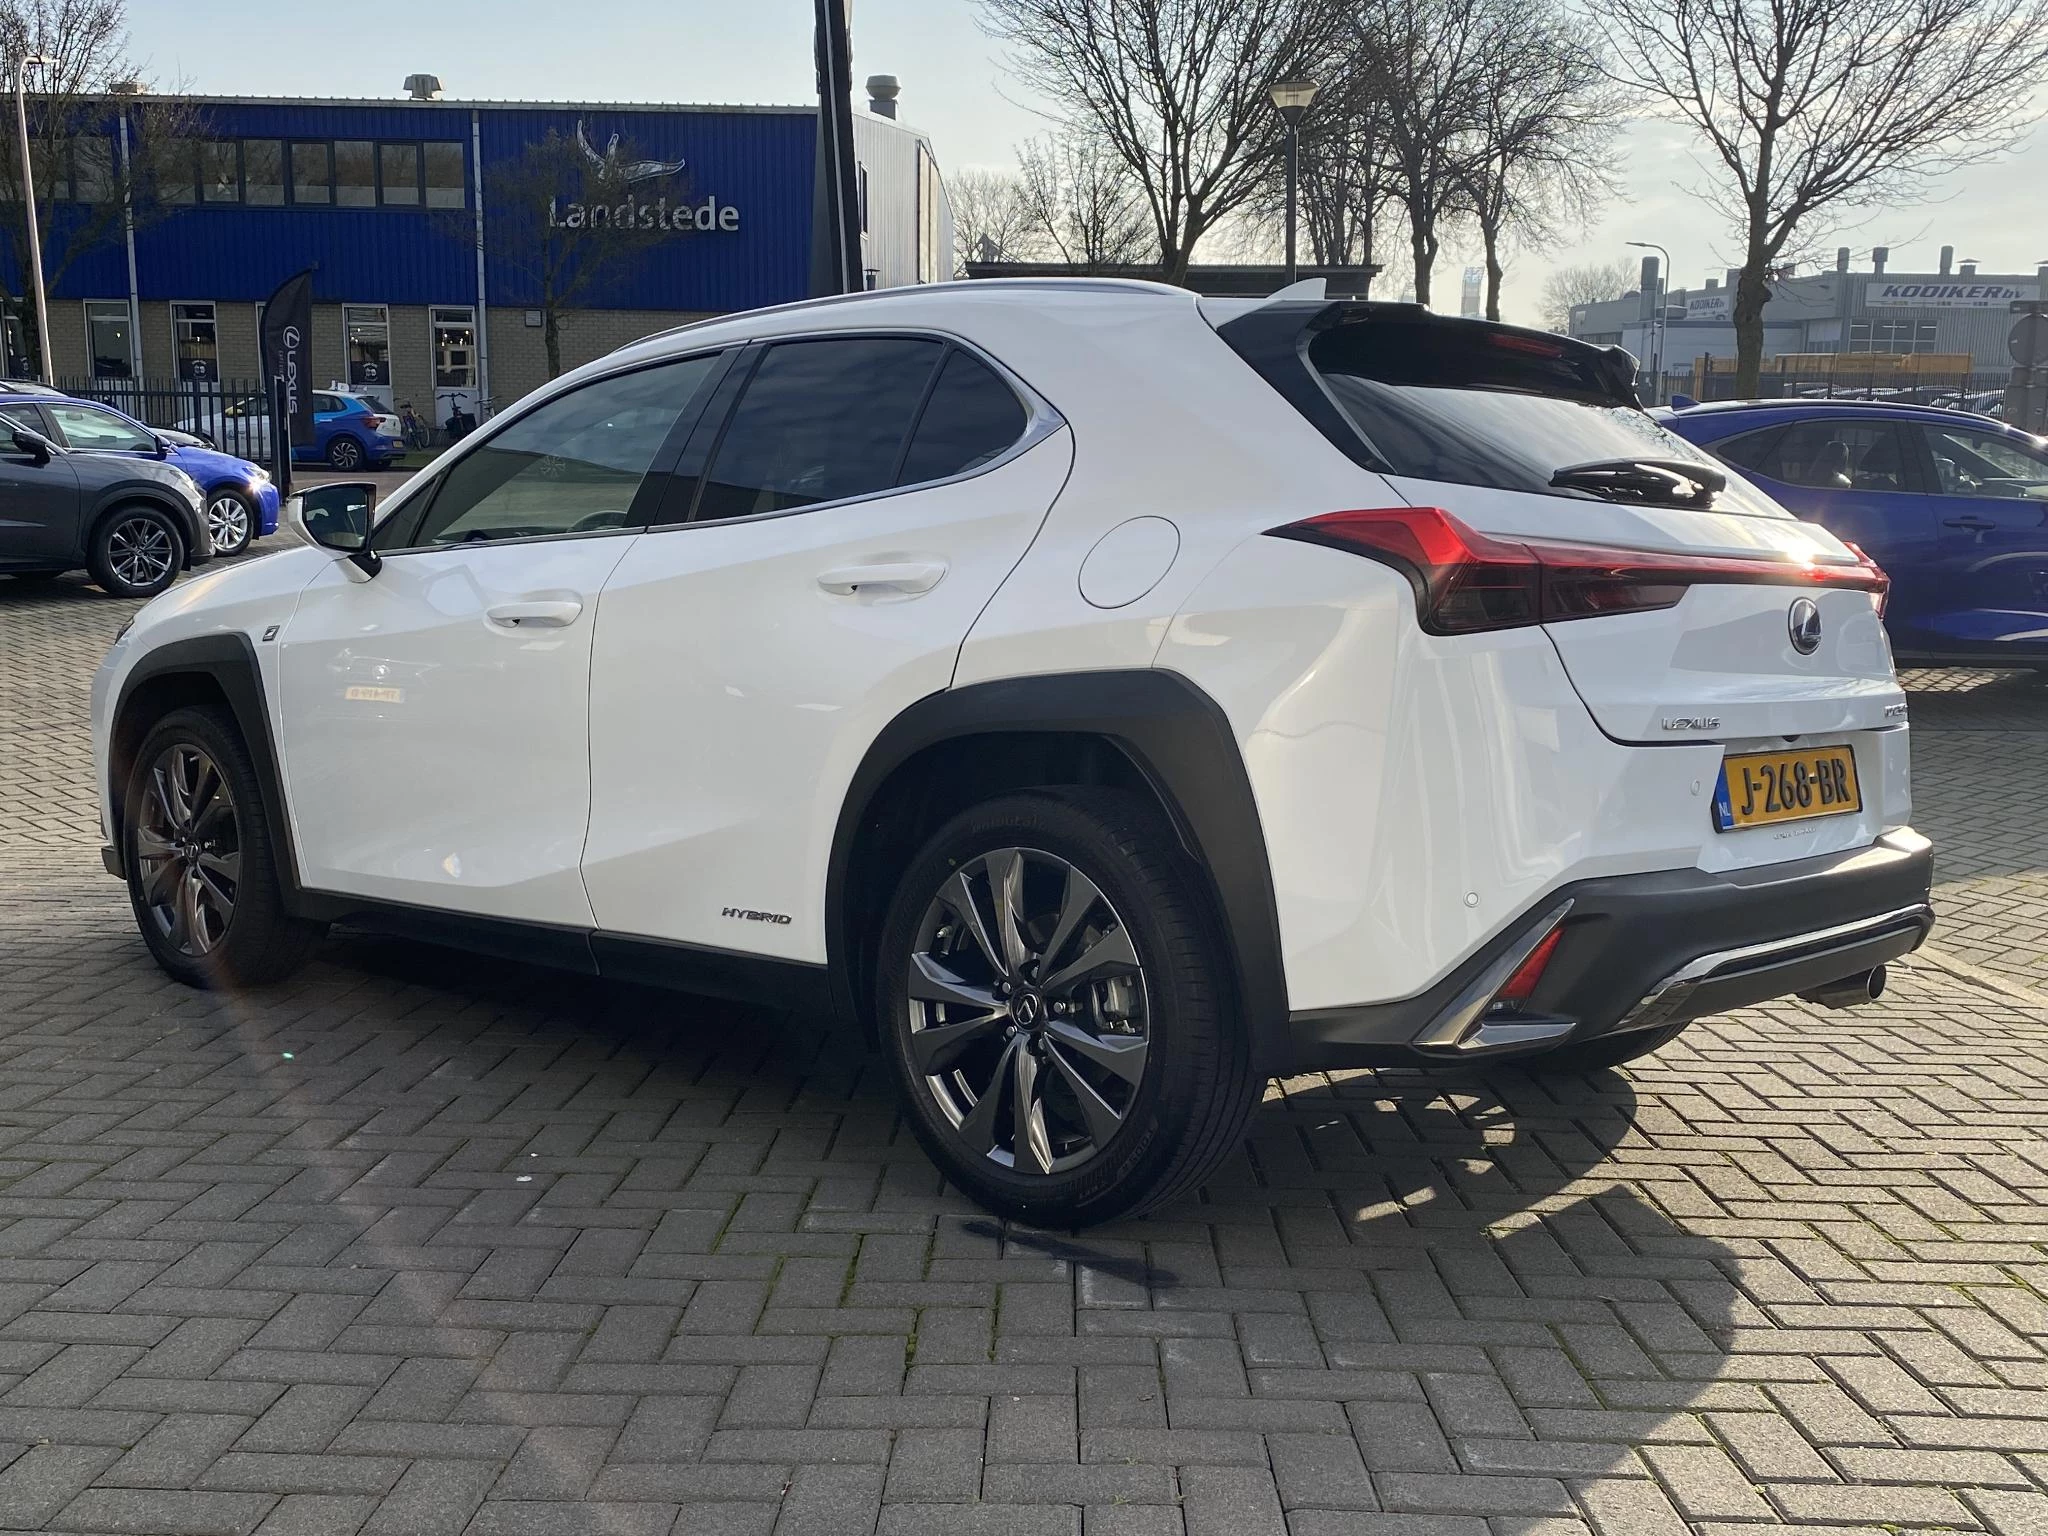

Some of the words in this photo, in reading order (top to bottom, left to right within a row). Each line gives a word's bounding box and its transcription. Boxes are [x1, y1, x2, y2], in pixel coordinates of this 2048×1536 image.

[549, 194, 740, 231] Landstede
[1882, 285, 2004, 299] KOOIKER
[286, 350, 299, 415] LEXUS
[1661, 717, 1721, 731] LEXUS
[1741, 758, 1851, 816] J-268-BR
[1718, 802, 1732, 817] NL
[721, 907, 792, 925] HYBRID
